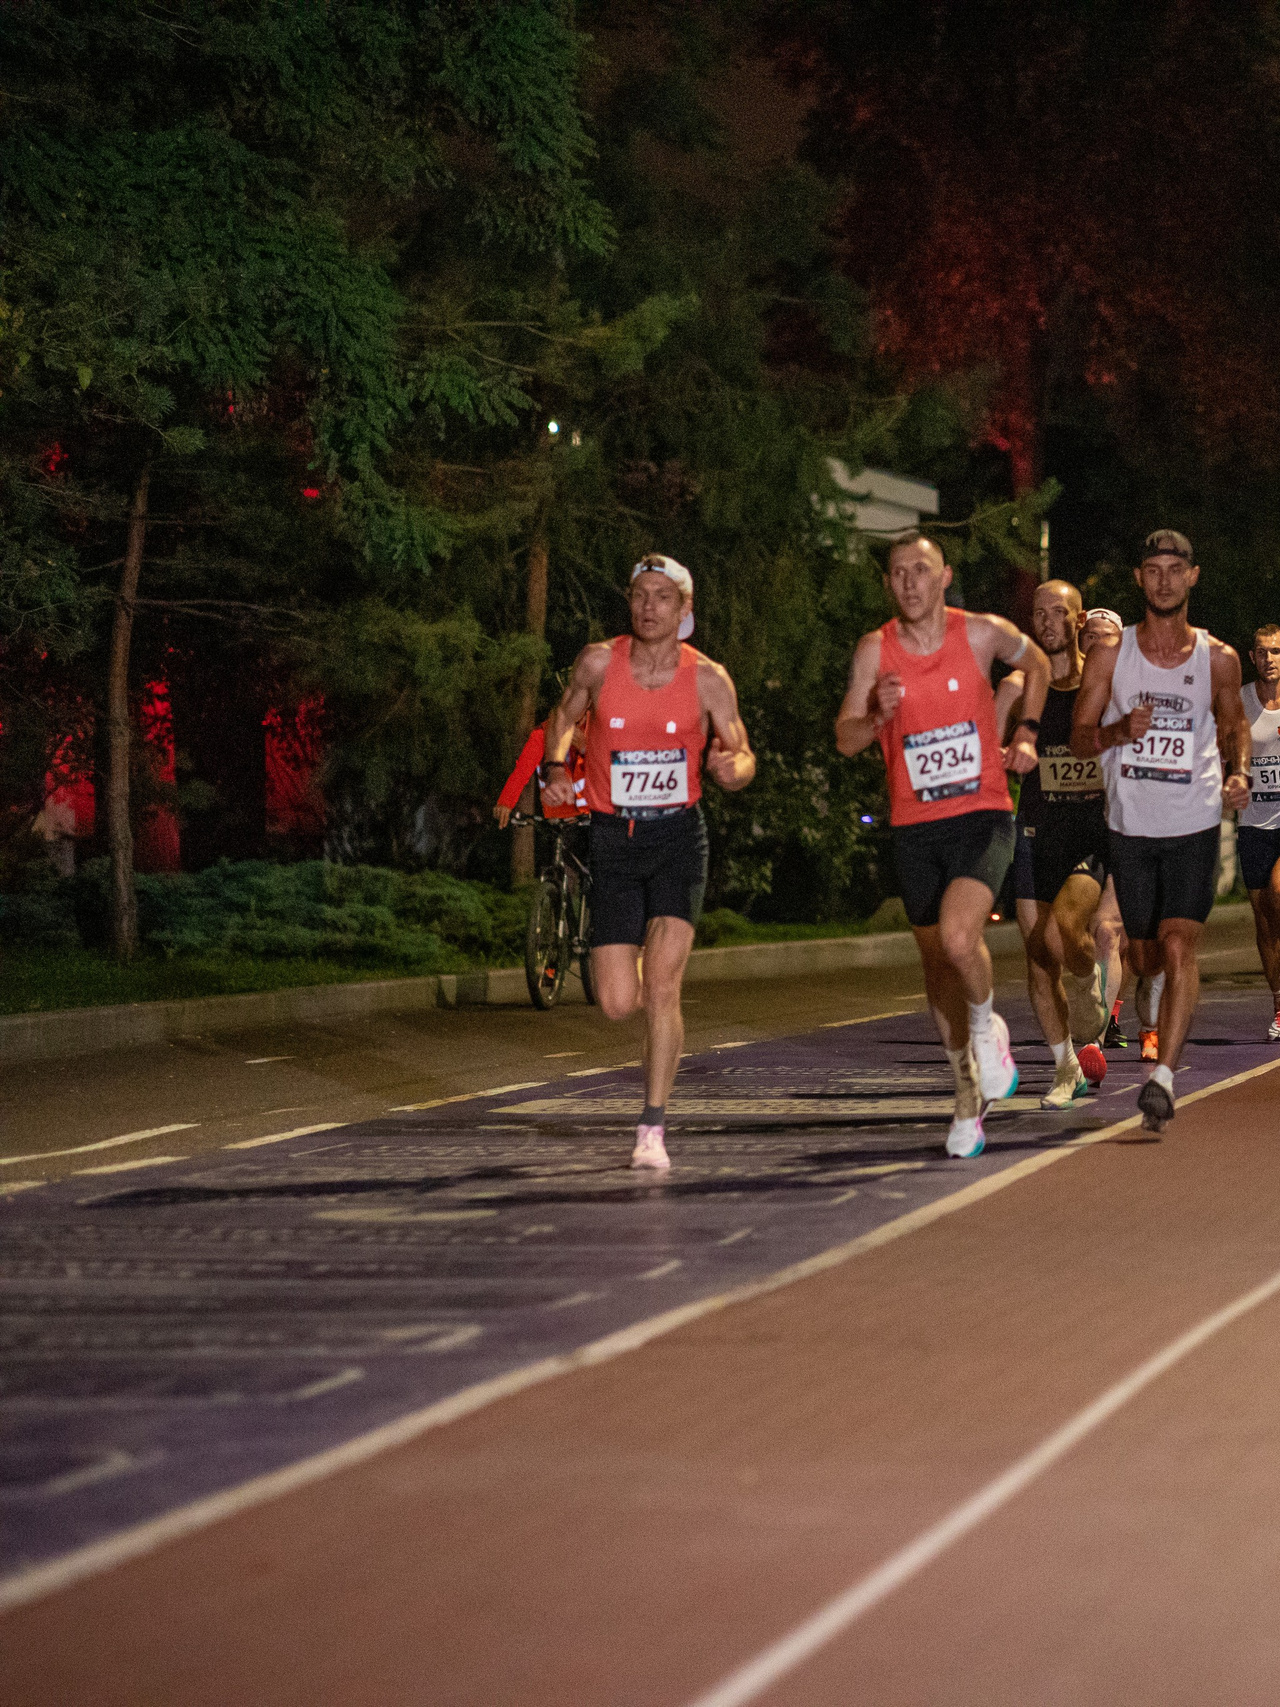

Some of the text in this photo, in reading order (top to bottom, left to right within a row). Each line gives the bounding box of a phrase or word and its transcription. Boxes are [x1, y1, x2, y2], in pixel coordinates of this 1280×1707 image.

[916, 742, 974, 775] 2934
[1132, 737, 1185, 758] 5178
[622, 770, 678, 793] 7746
[1049, 761, 1097, 780] 1292
